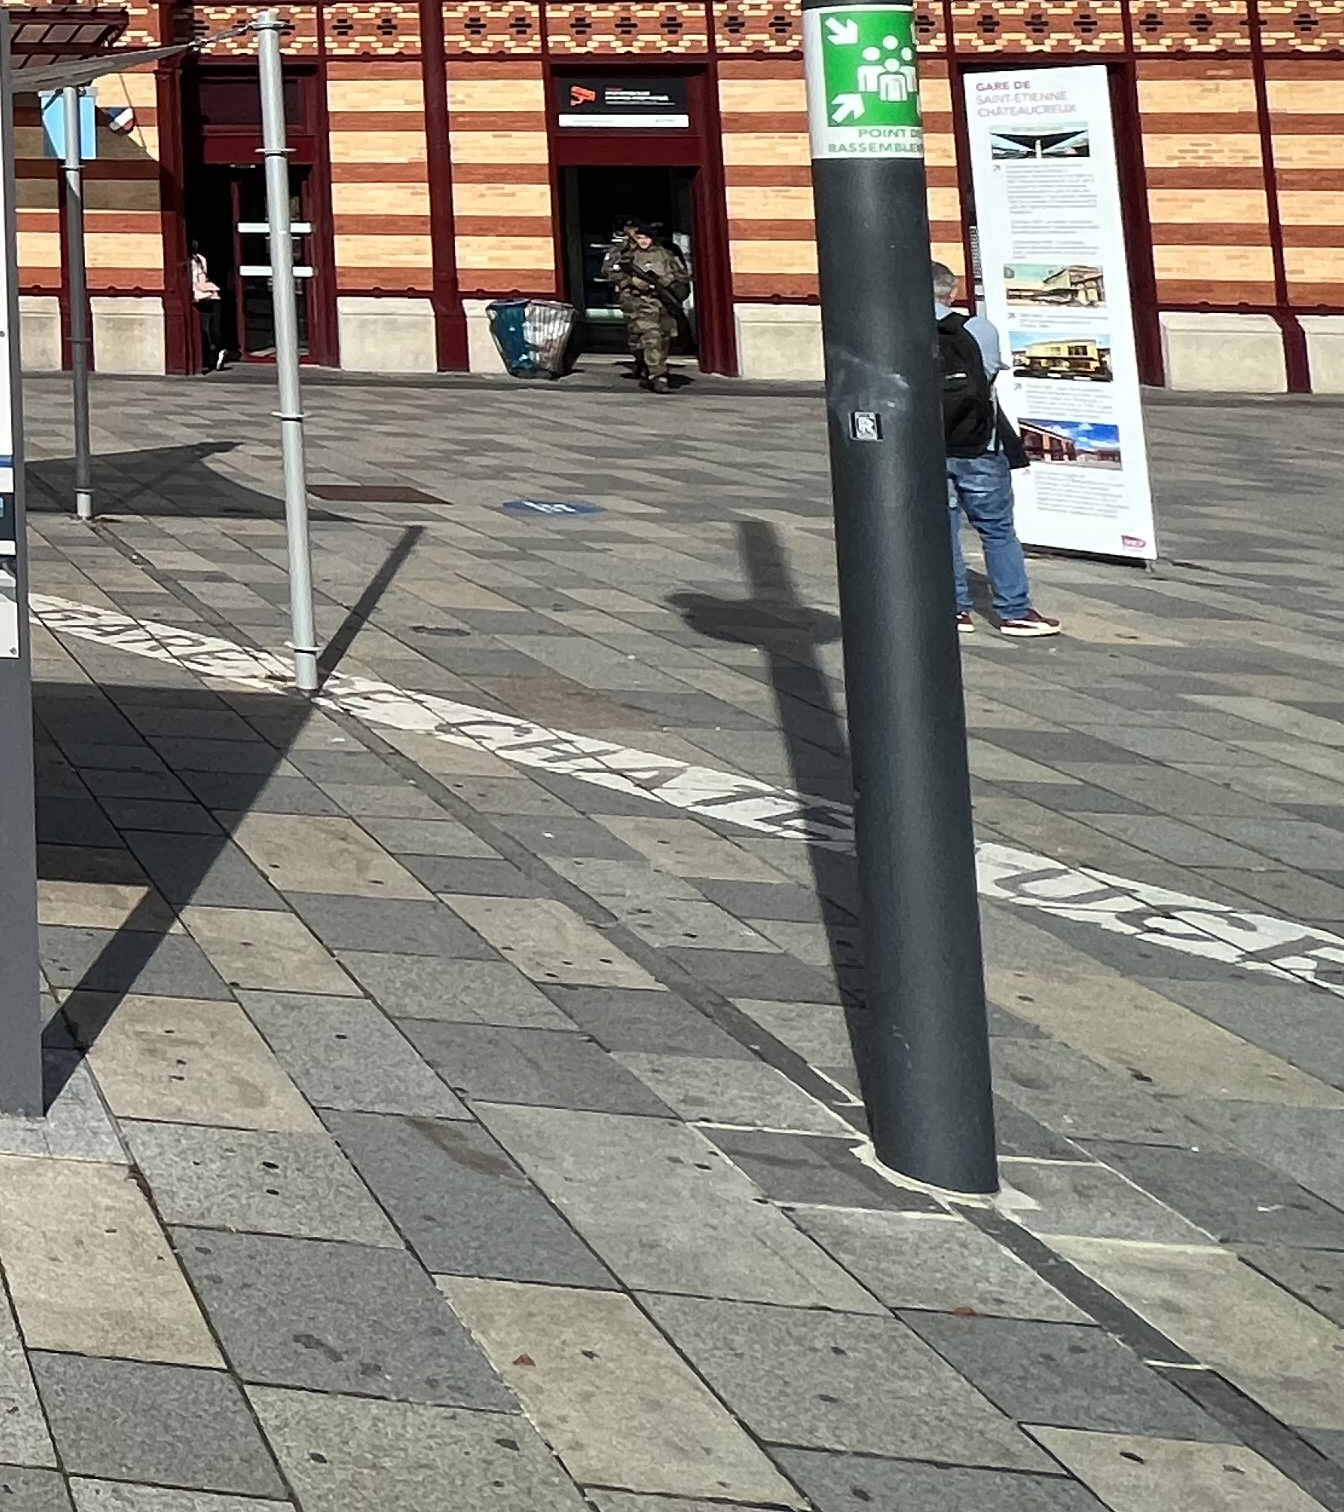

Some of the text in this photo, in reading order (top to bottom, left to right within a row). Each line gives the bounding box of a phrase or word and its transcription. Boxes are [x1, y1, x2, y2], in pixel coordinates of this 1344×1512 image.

[975, 79, 1031, 92] GARE DE
[858, 128, 907, 138] POINT
